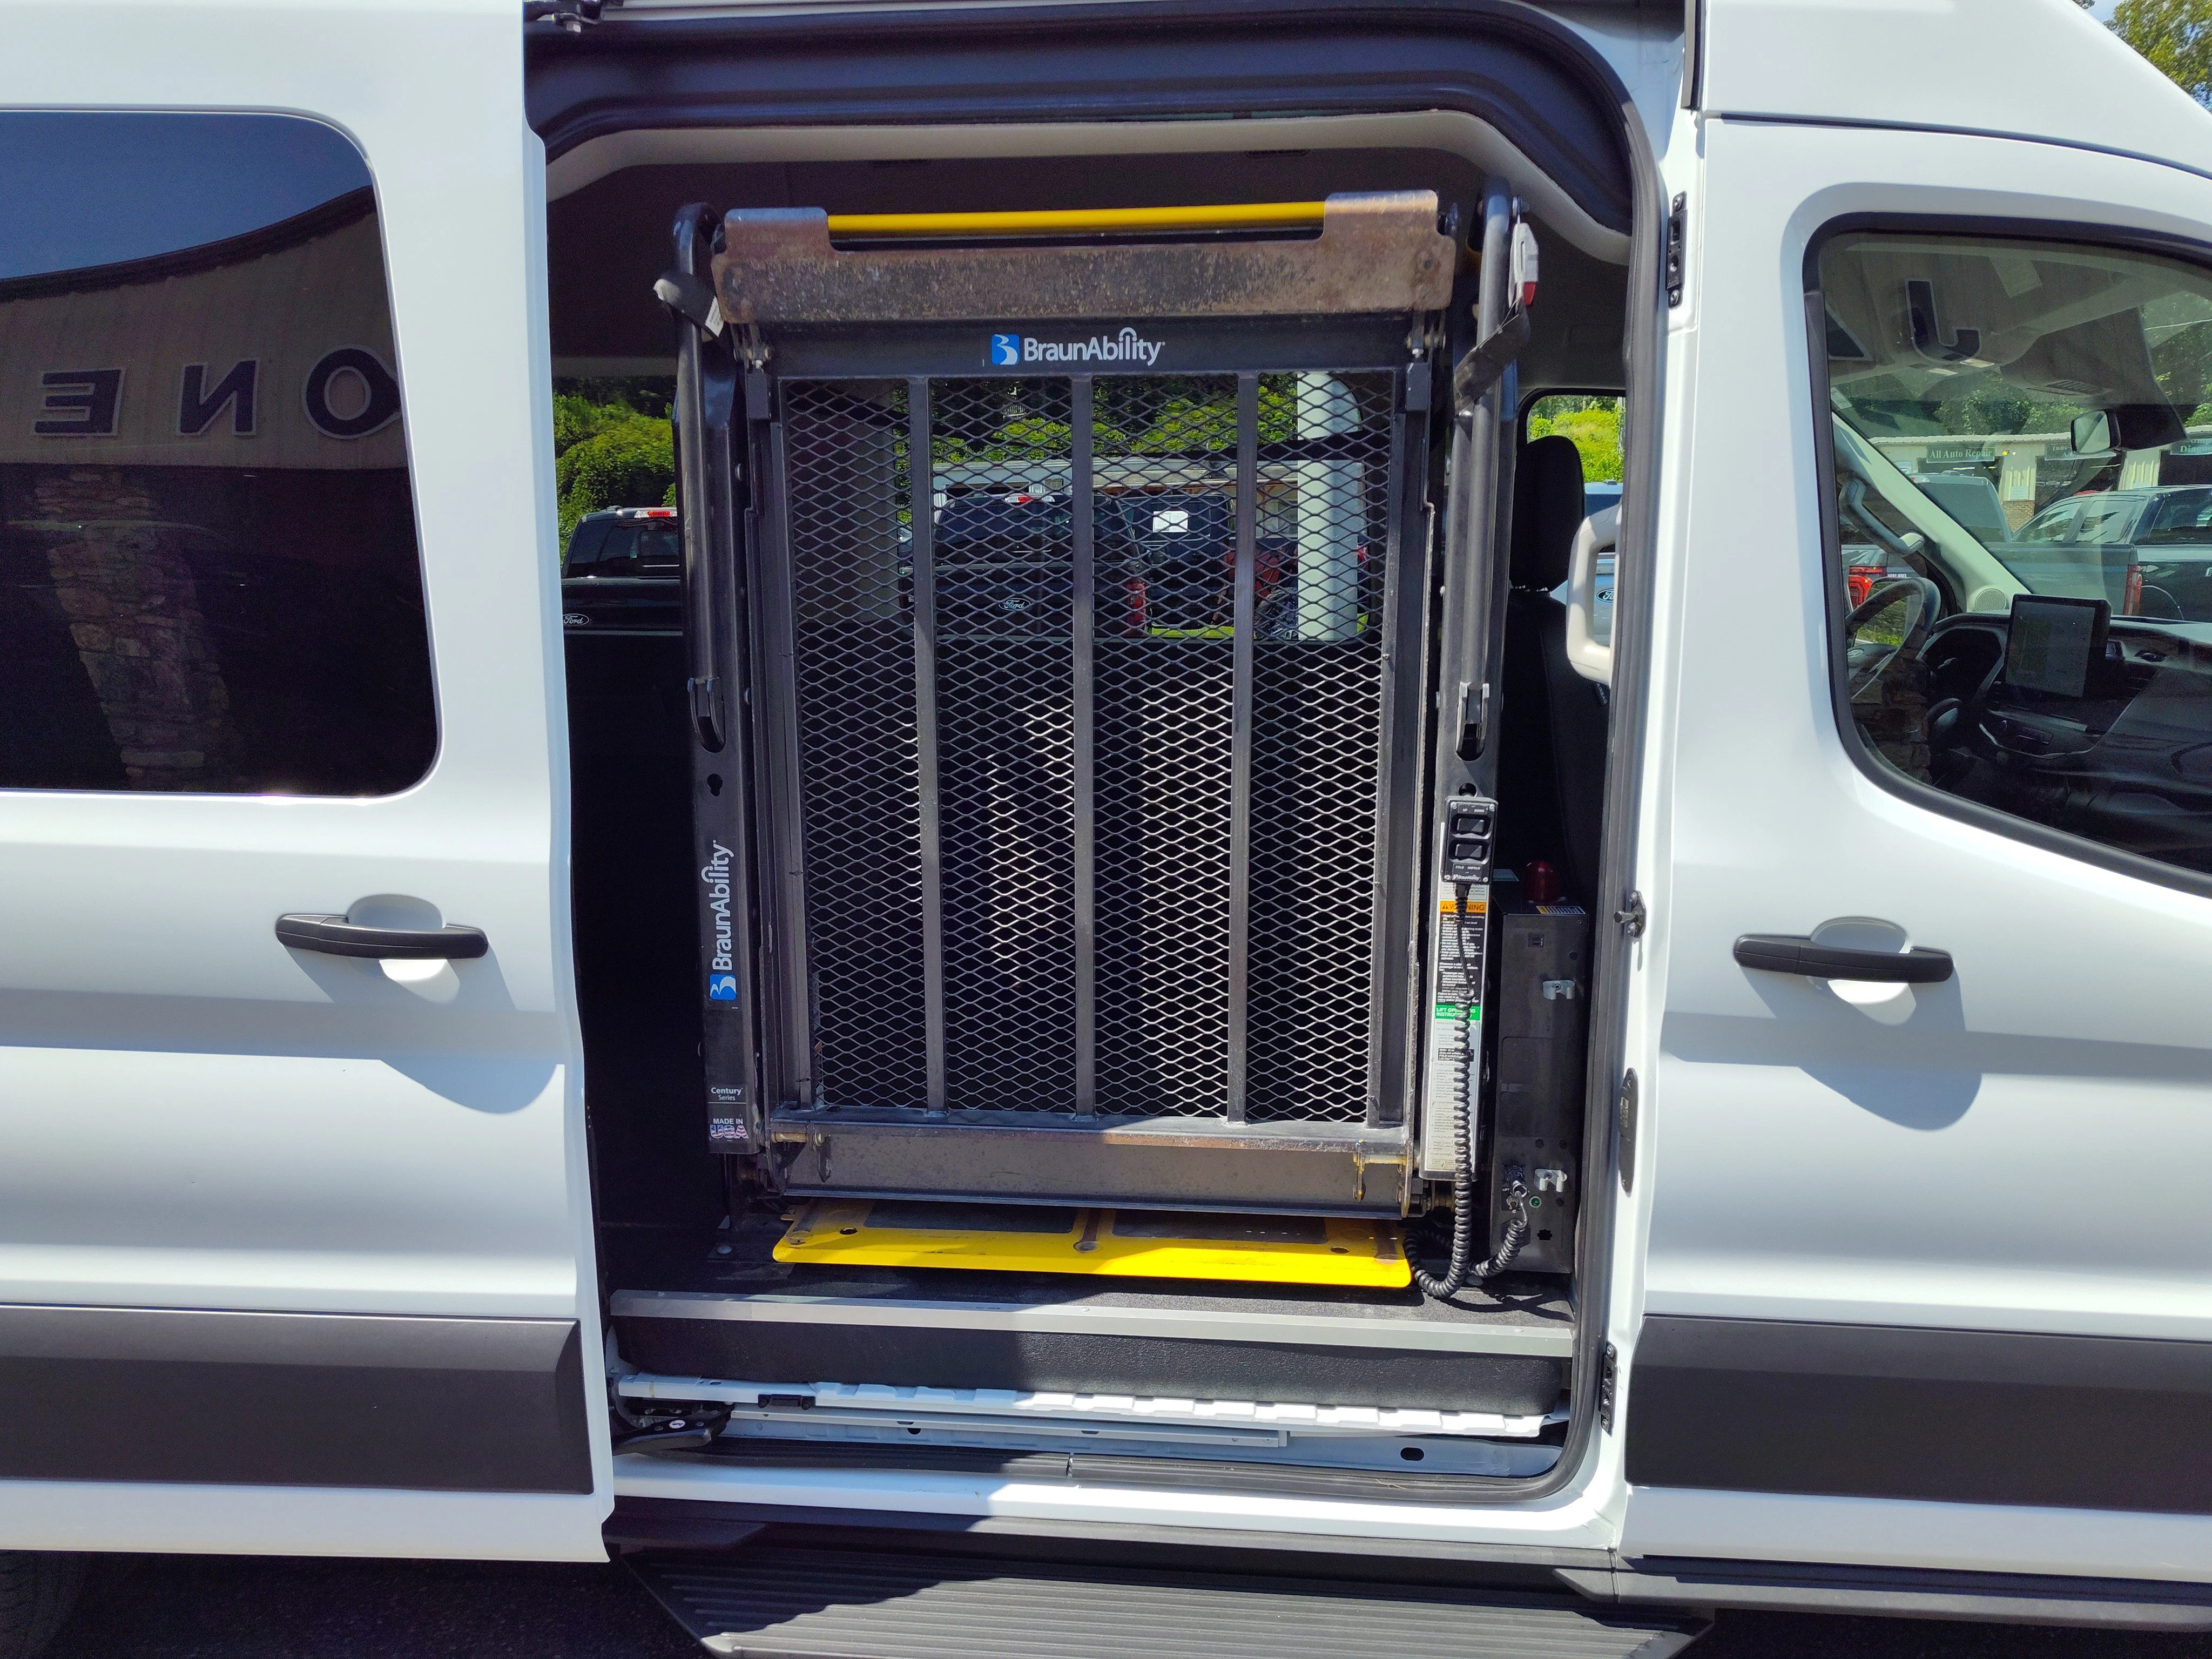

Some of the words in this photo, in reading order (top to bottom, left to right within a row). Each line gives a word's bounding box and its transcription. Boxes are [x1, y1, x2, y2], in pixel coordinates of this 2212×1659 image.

[1024, 327, 1162, 367] BraunAbility
[1930, 450, 1941, 458] All
[1943, 450, 1963, 458] Auto
[1965, 449, 1992, 459] Repair
[1004, 599, 1025, 609] Ford
[563, 615, 584, 624] Ford
[1596, 683, 1608, 704] AIRBAG
[701, 843, 735, 970] BraunAbility
[711, 1087, 741, 1096] Century
[710, 1124, 749, 1139] USA
